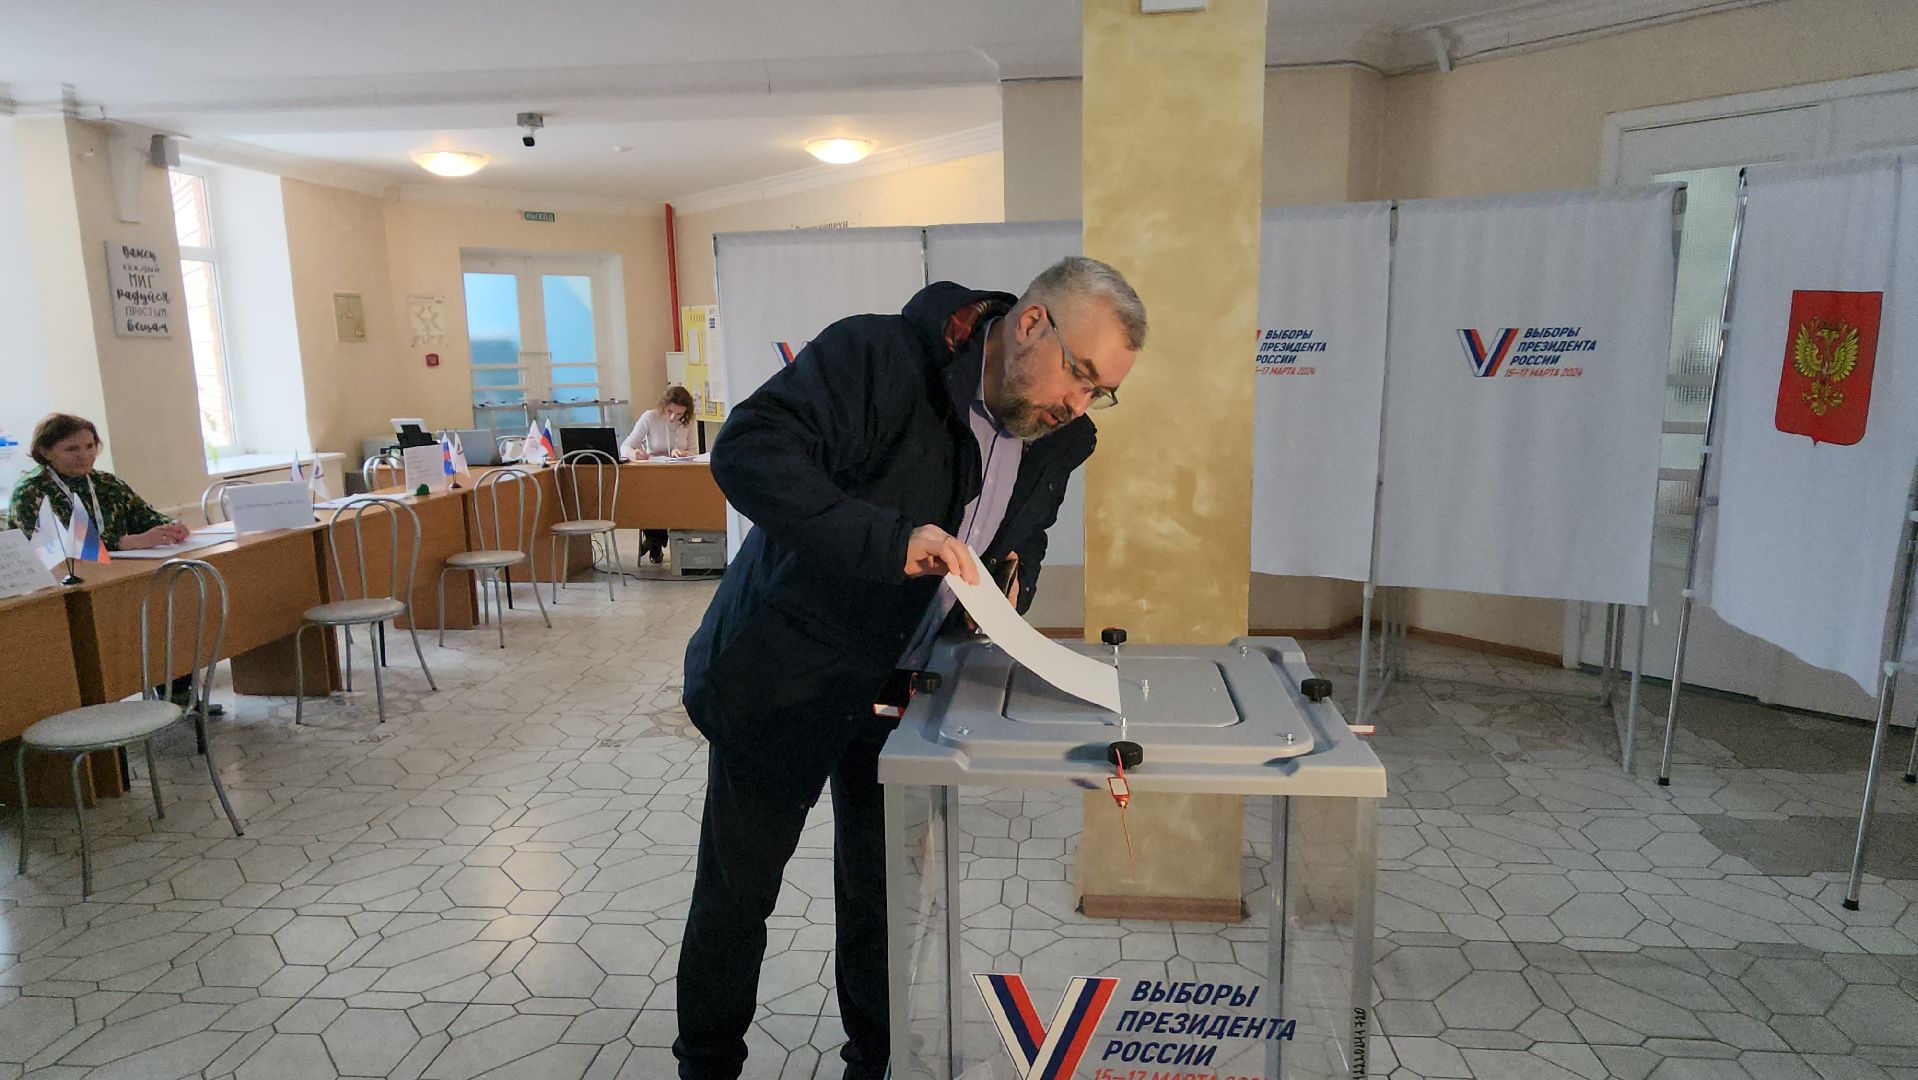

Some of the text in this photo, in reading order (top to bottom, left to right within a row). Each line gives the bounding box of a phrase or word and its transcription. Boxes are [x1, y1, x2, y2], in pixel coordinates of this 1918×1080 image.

[1265, 329, 1314, 340] ВЫБОРЫ
[1524, 327, 1581, 339] ВЫБОРЫ
[1260, 342, 1326, 352] ПРЕЗИДЕНТА
[1517, 340, 1597, 353] ПРЕЗИДЕНТА
[1256, 355, 1297, 364] РОССИИ
[1510, 355, 1561, 366] РОССИИ
[1529, 368, 1560, 377] МАРТА
[1130, 980, 1260, 1008] ВЫБОРЫ
[1116, 1010, 1297, 1041] ПРЕЗИДЕНТА
[1102, 1040, 1218, 1067] РОССИИ
